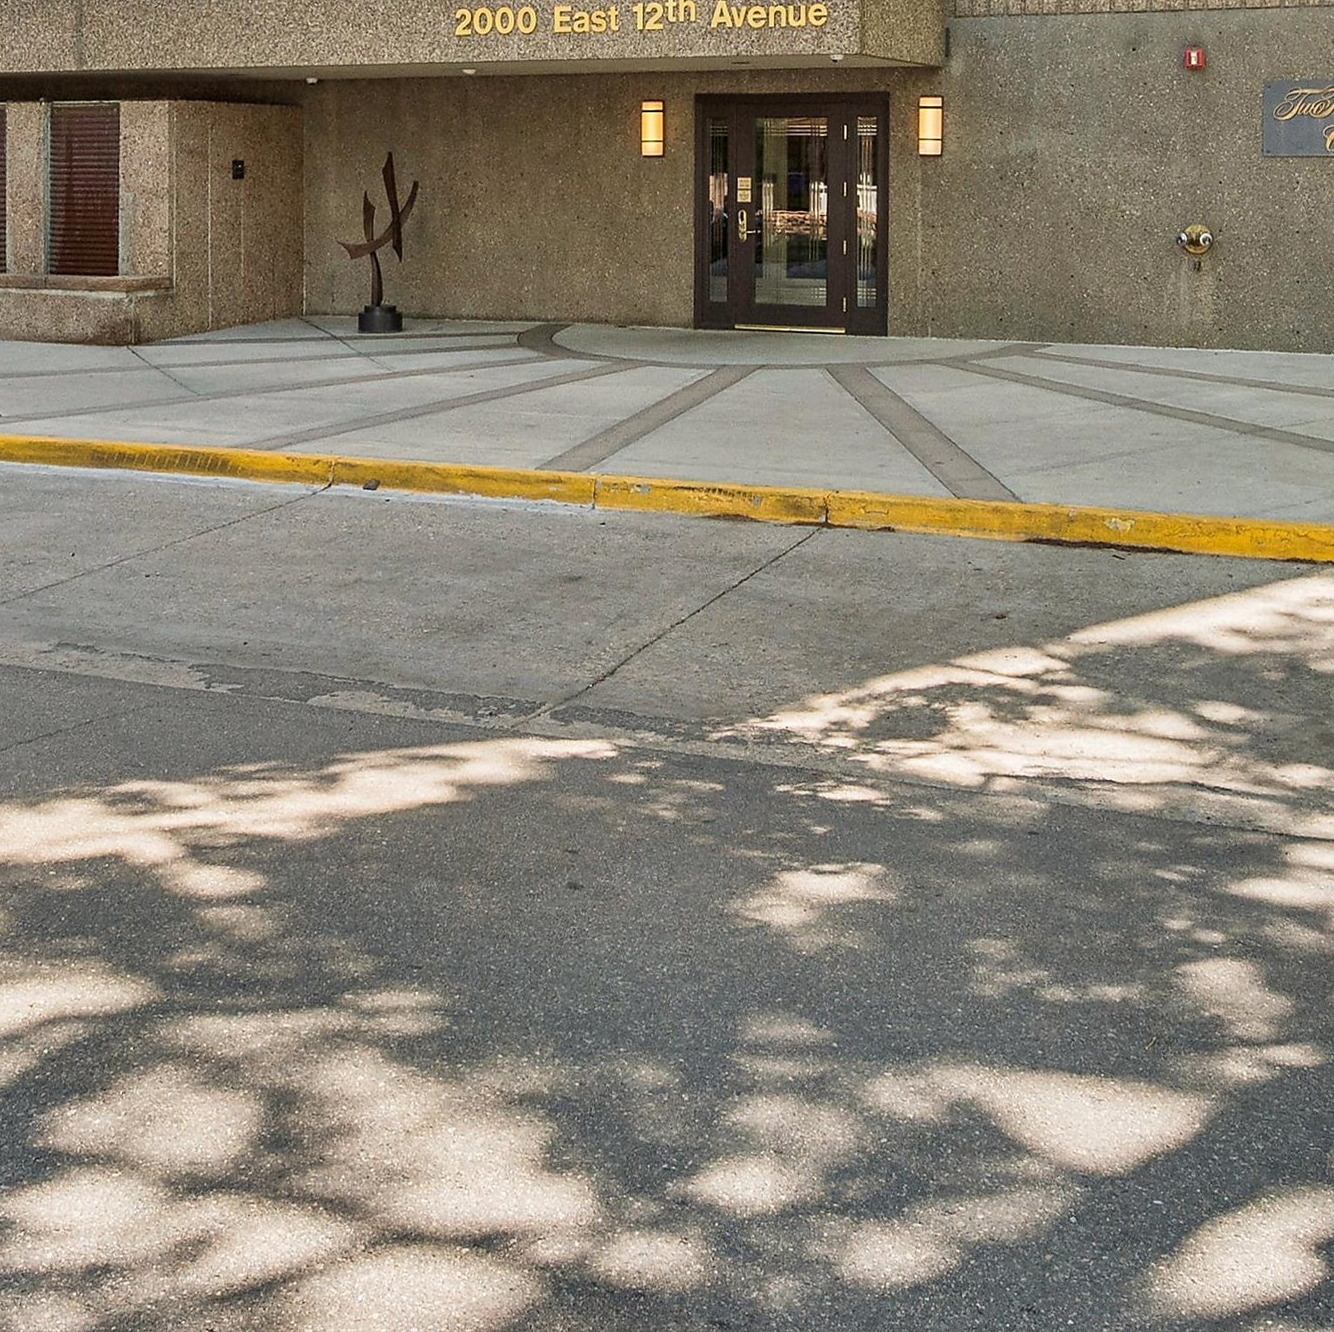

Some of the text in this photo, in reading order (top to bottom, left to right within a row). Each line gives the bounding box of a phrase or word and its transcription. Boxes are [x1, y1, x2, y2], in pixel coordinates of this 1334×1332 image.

[455, 6, 537, 37] 2000
[553, 4, 620, 34] East
[710, 0, 830, 31] Avenue
[1273, 87, 1326, 121] Two
